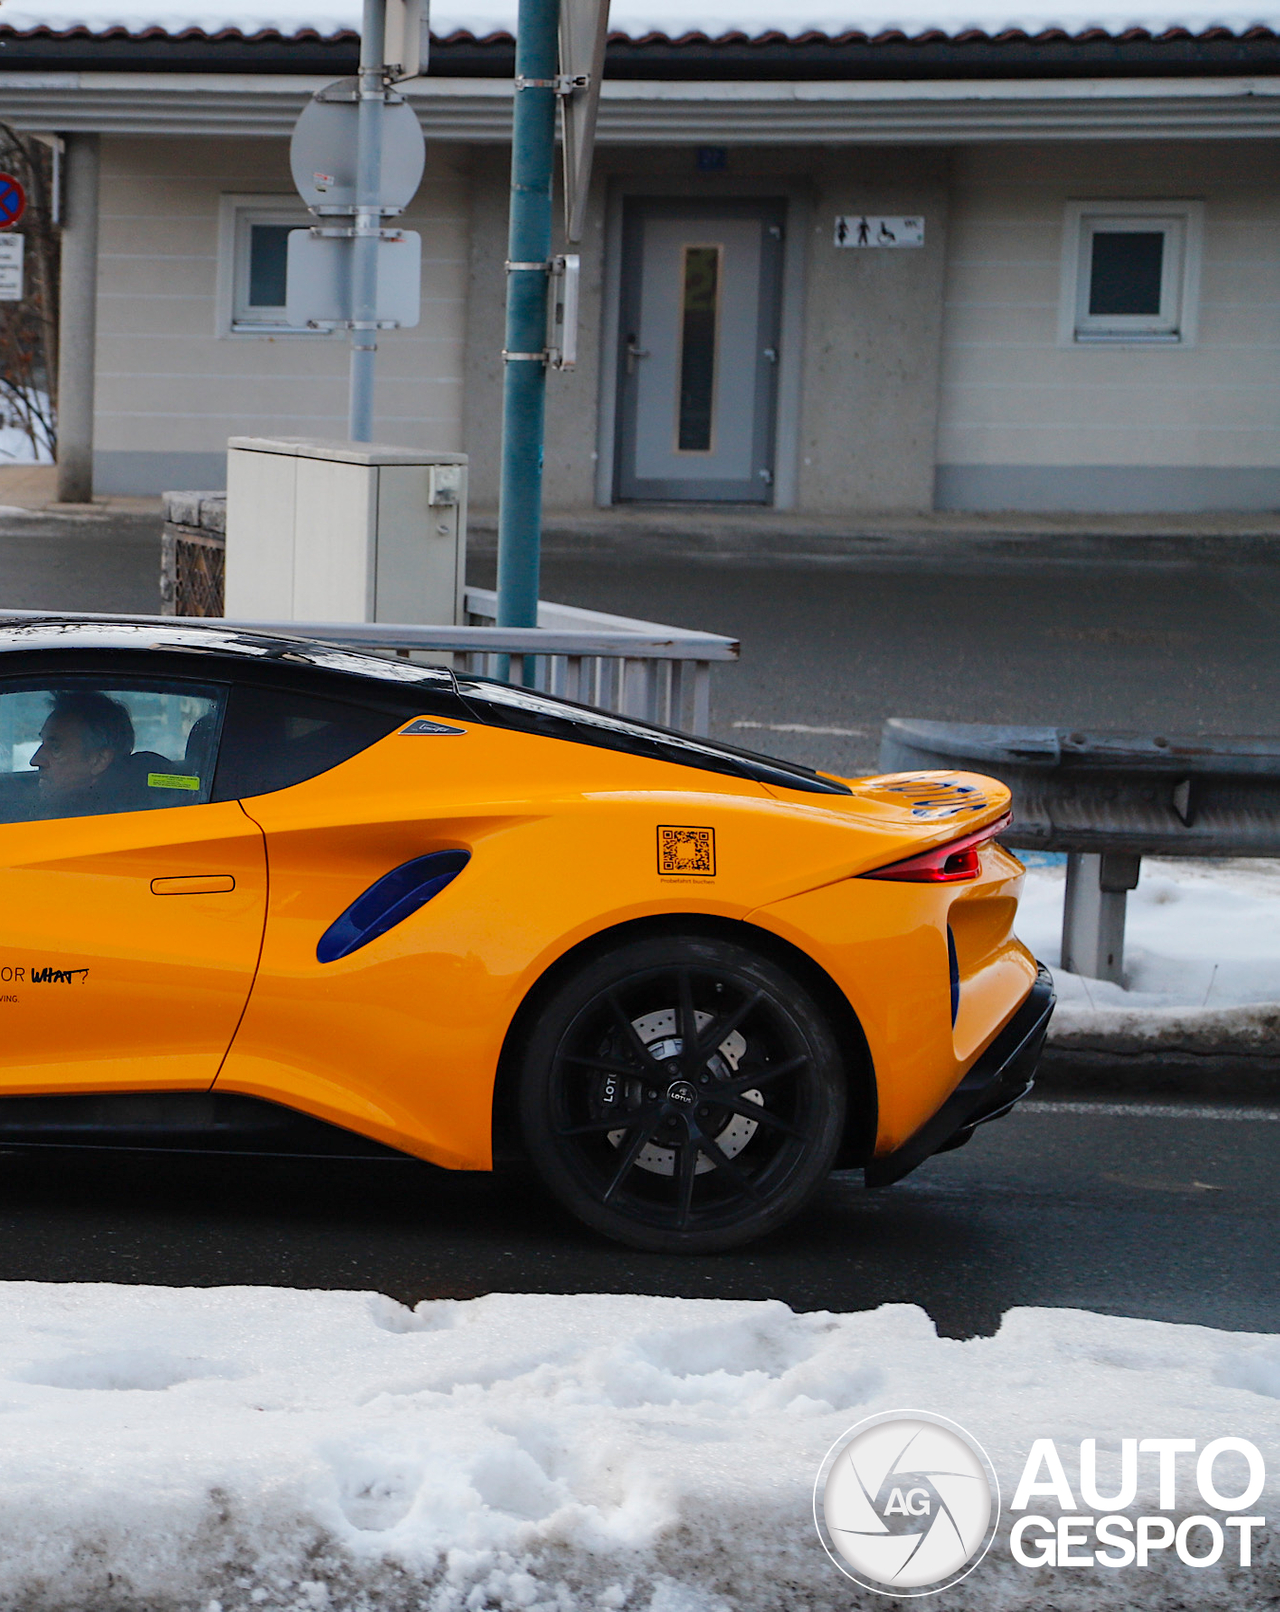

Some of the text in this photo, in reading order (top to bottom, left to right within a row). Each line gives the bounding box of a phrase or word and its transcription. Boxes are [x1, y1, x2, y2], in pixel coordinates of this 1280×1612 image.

[1, 966, 25, 982] OR
[31, 967, 90, 985] WHAT?
[670, 1092, 692, 1104] LOTUS
